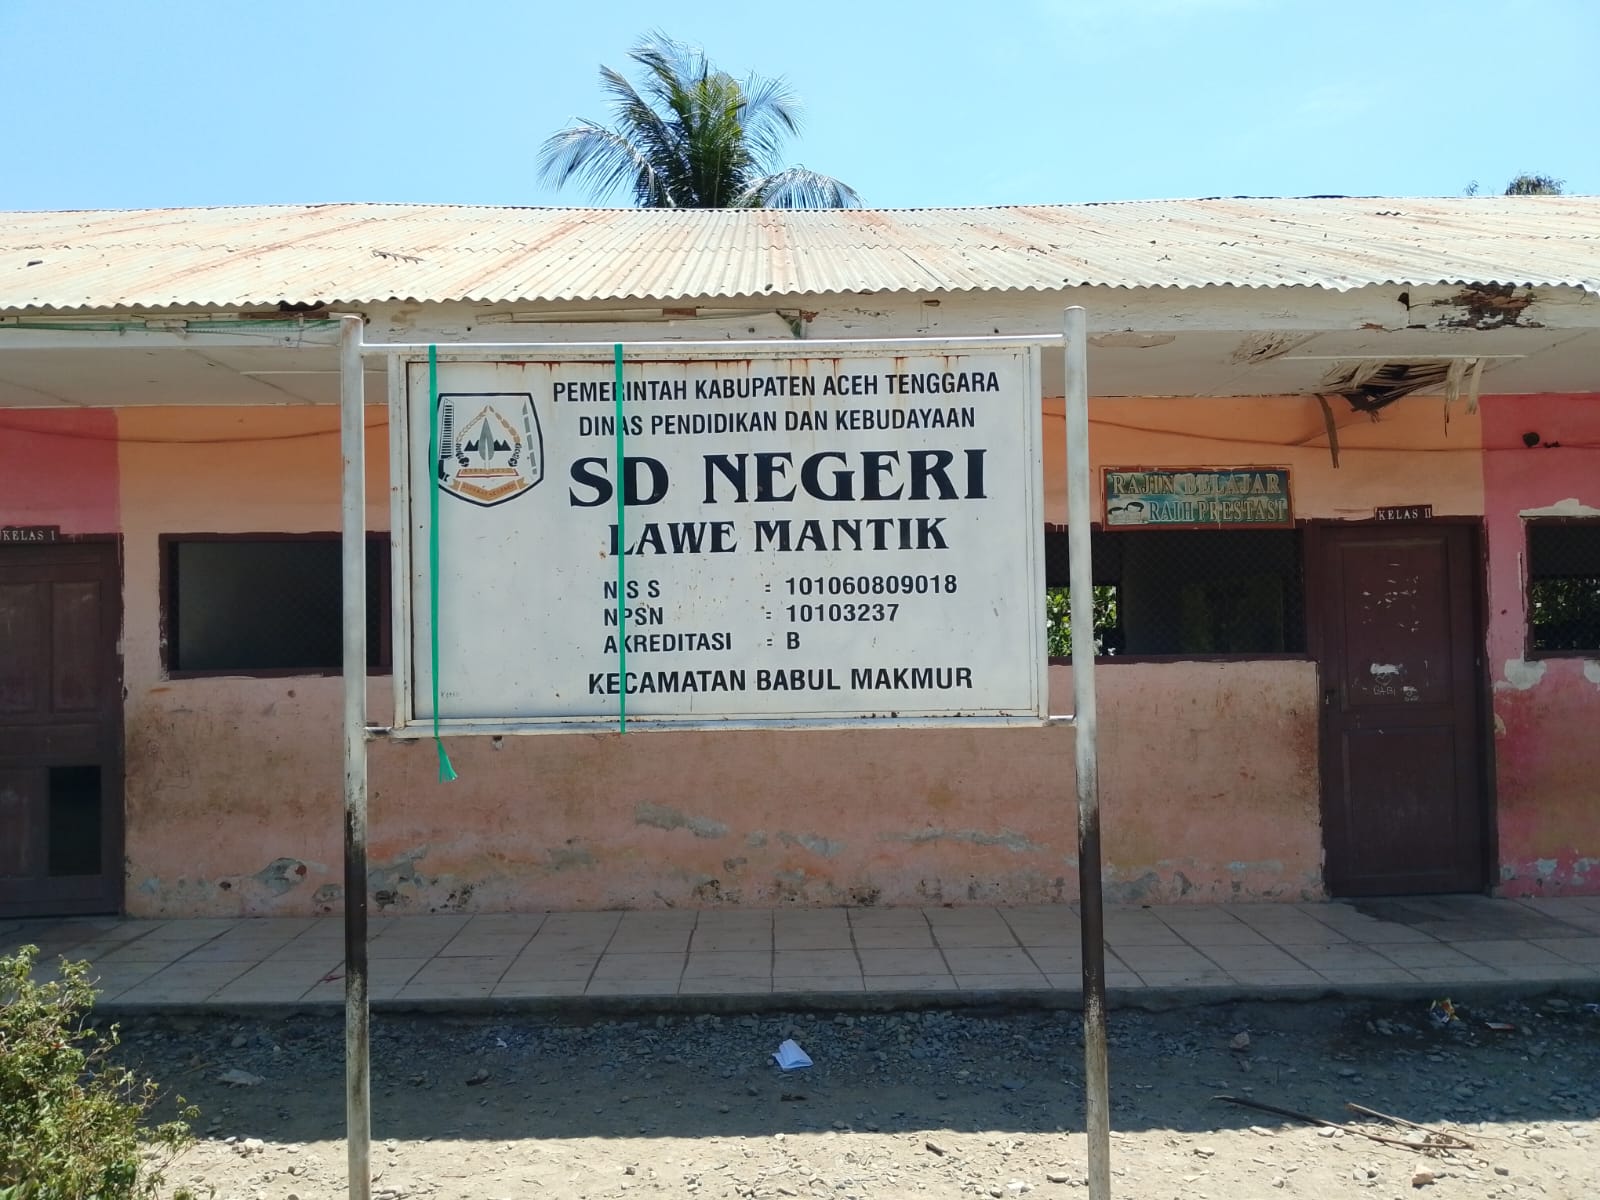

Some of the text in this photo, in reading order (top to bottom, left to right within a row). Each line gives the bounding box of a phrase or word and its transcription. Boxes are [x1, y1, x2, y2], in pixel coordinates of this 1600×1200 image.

[695, 376, 815, 400] KABUPATEN
[823, 375, 878, 396] ACEH
[885, 372, 1000, 394] TENGGARA
[579, 407, 975, 436] DINAS PENDIDIKAN DAN KEBUDAYAAN
[569, 449, 987, 507] SD NEGERI
[1112, 473, 1281, 495] RAJIN BELAJAR
[1150, 499, 1285, 521] RAIH PRESTASI
[1378, 508, 1418, 520] KELAS
[2, 530, 44, 541] KELAS
[609, 517, 949, 555] LAWE MANTIK
[785, 575, 957, 595] 101060809018
[604, 607, 663, 626] NPSN
[786, 604, 899, 622] 10103237
[604, 632, 731, 654] AKREDITASI
[787, 631, 800, 650] B
[588, 667, 973, 694] KECAMATAN BABUL MAKMUR
